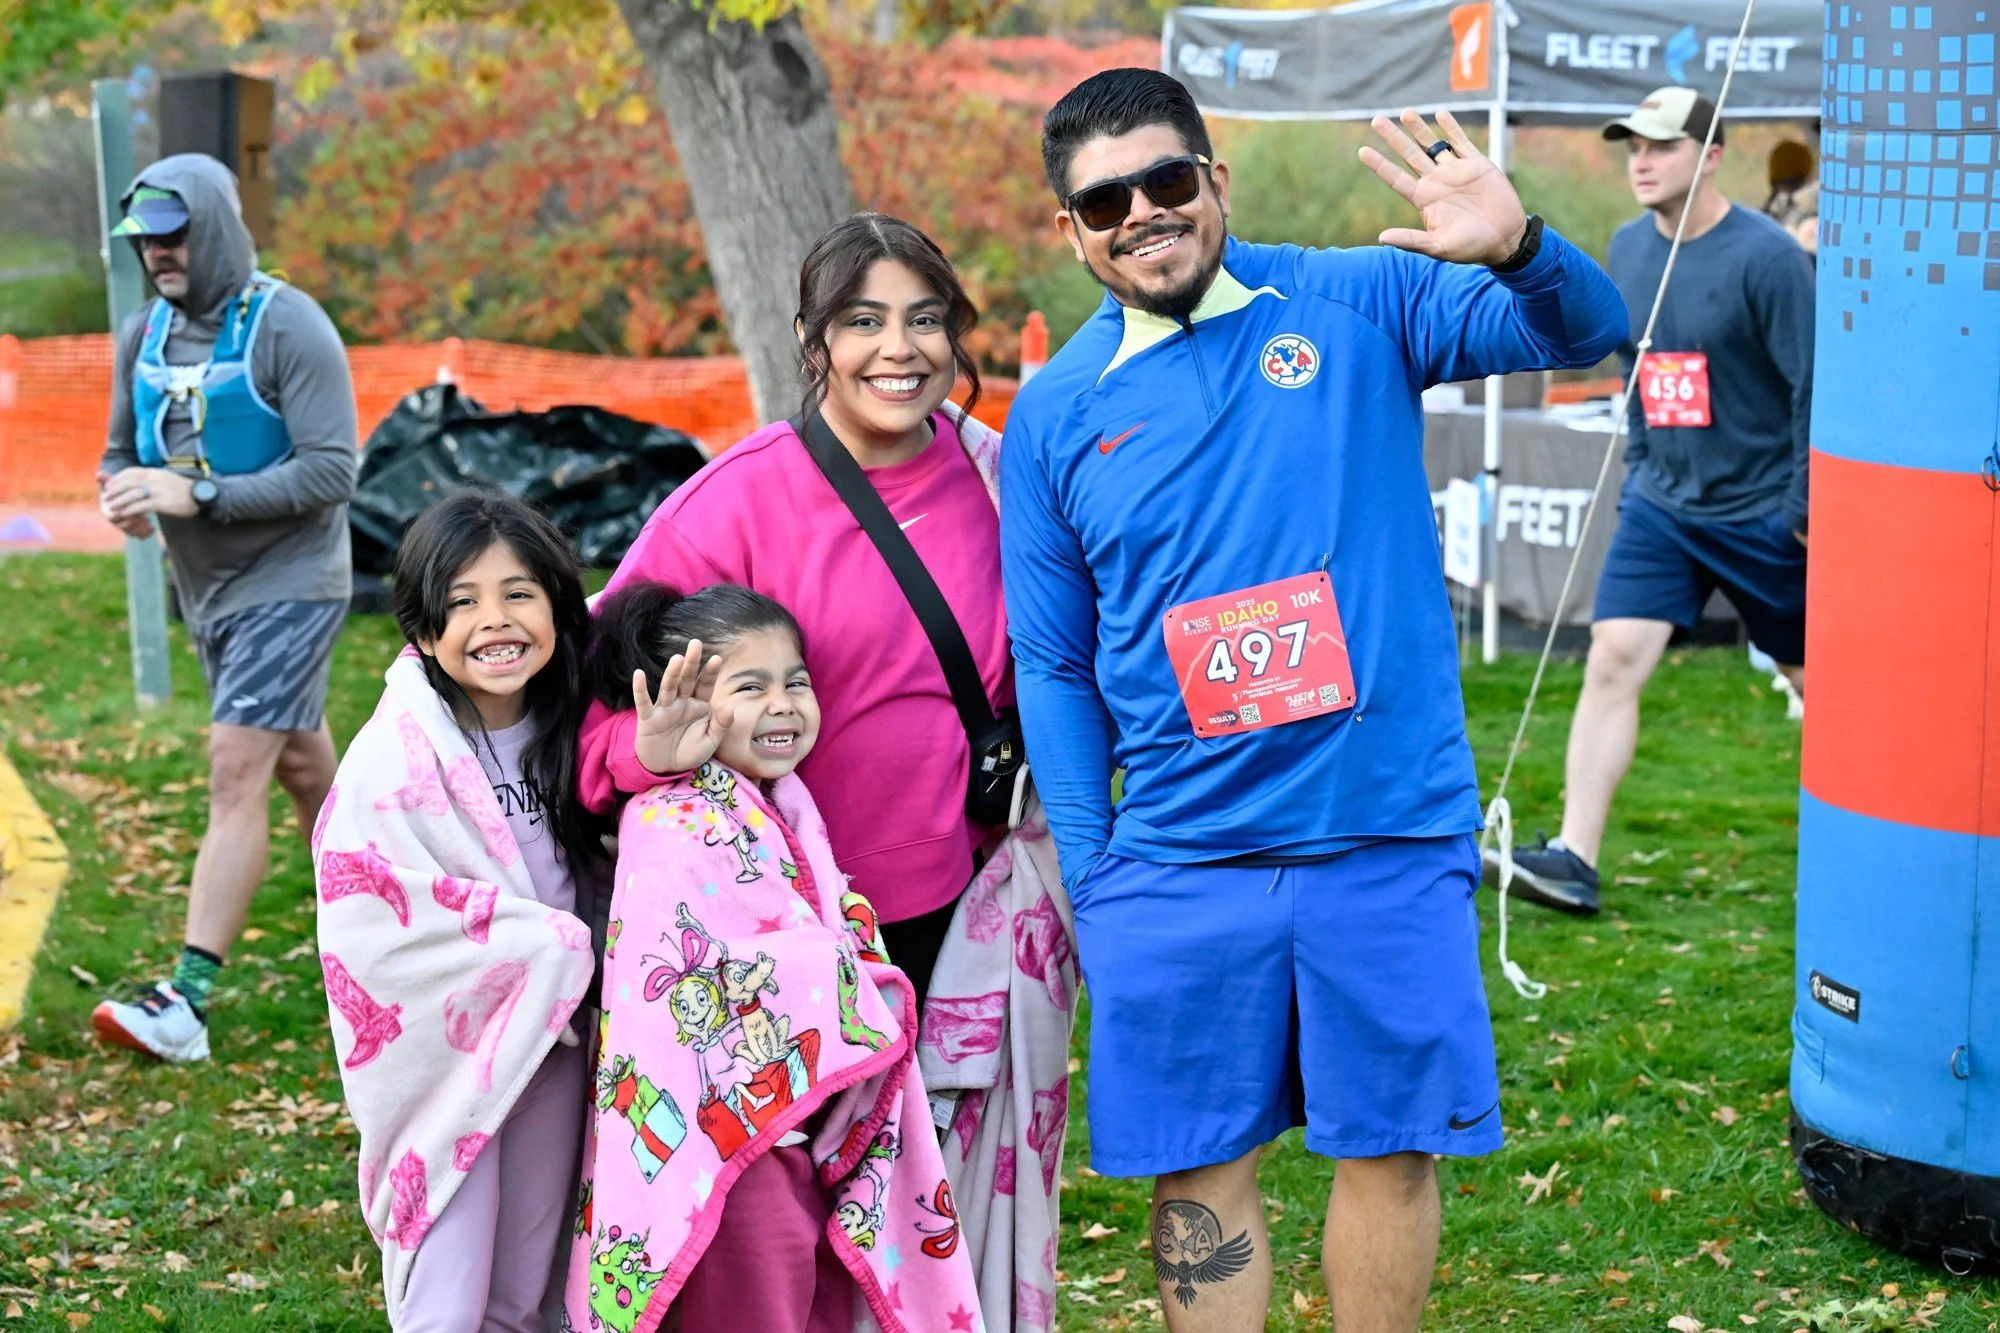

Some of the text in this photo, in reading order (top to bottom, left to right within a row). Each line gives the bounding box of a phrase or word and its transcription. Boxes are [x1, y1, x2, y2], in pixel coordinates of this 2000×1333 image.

[1545, 33, 1803, 72] FLEET FEET
[1648, 376, 1694, 400] 456
[1495, 484, 1594, 548] FEET
[1236, 599, 1255, 609] 2025
[1290, 589, 1323, 609] 10K
[1217, 600, 1278, 627] IDAHO
[1221, 613, 1280, 633] RUNNING DAY
[1184, 626, 1213, 637] RUNNING
[1206, 619, 1309, 684] 497
[1285, 692, 1308, 703] FLEET
[1288, 699, 1307, 708] FEET
[1208, 714, 1236, 725] RESULTS
[1821, 985, 1856, 1011] STRIKE
